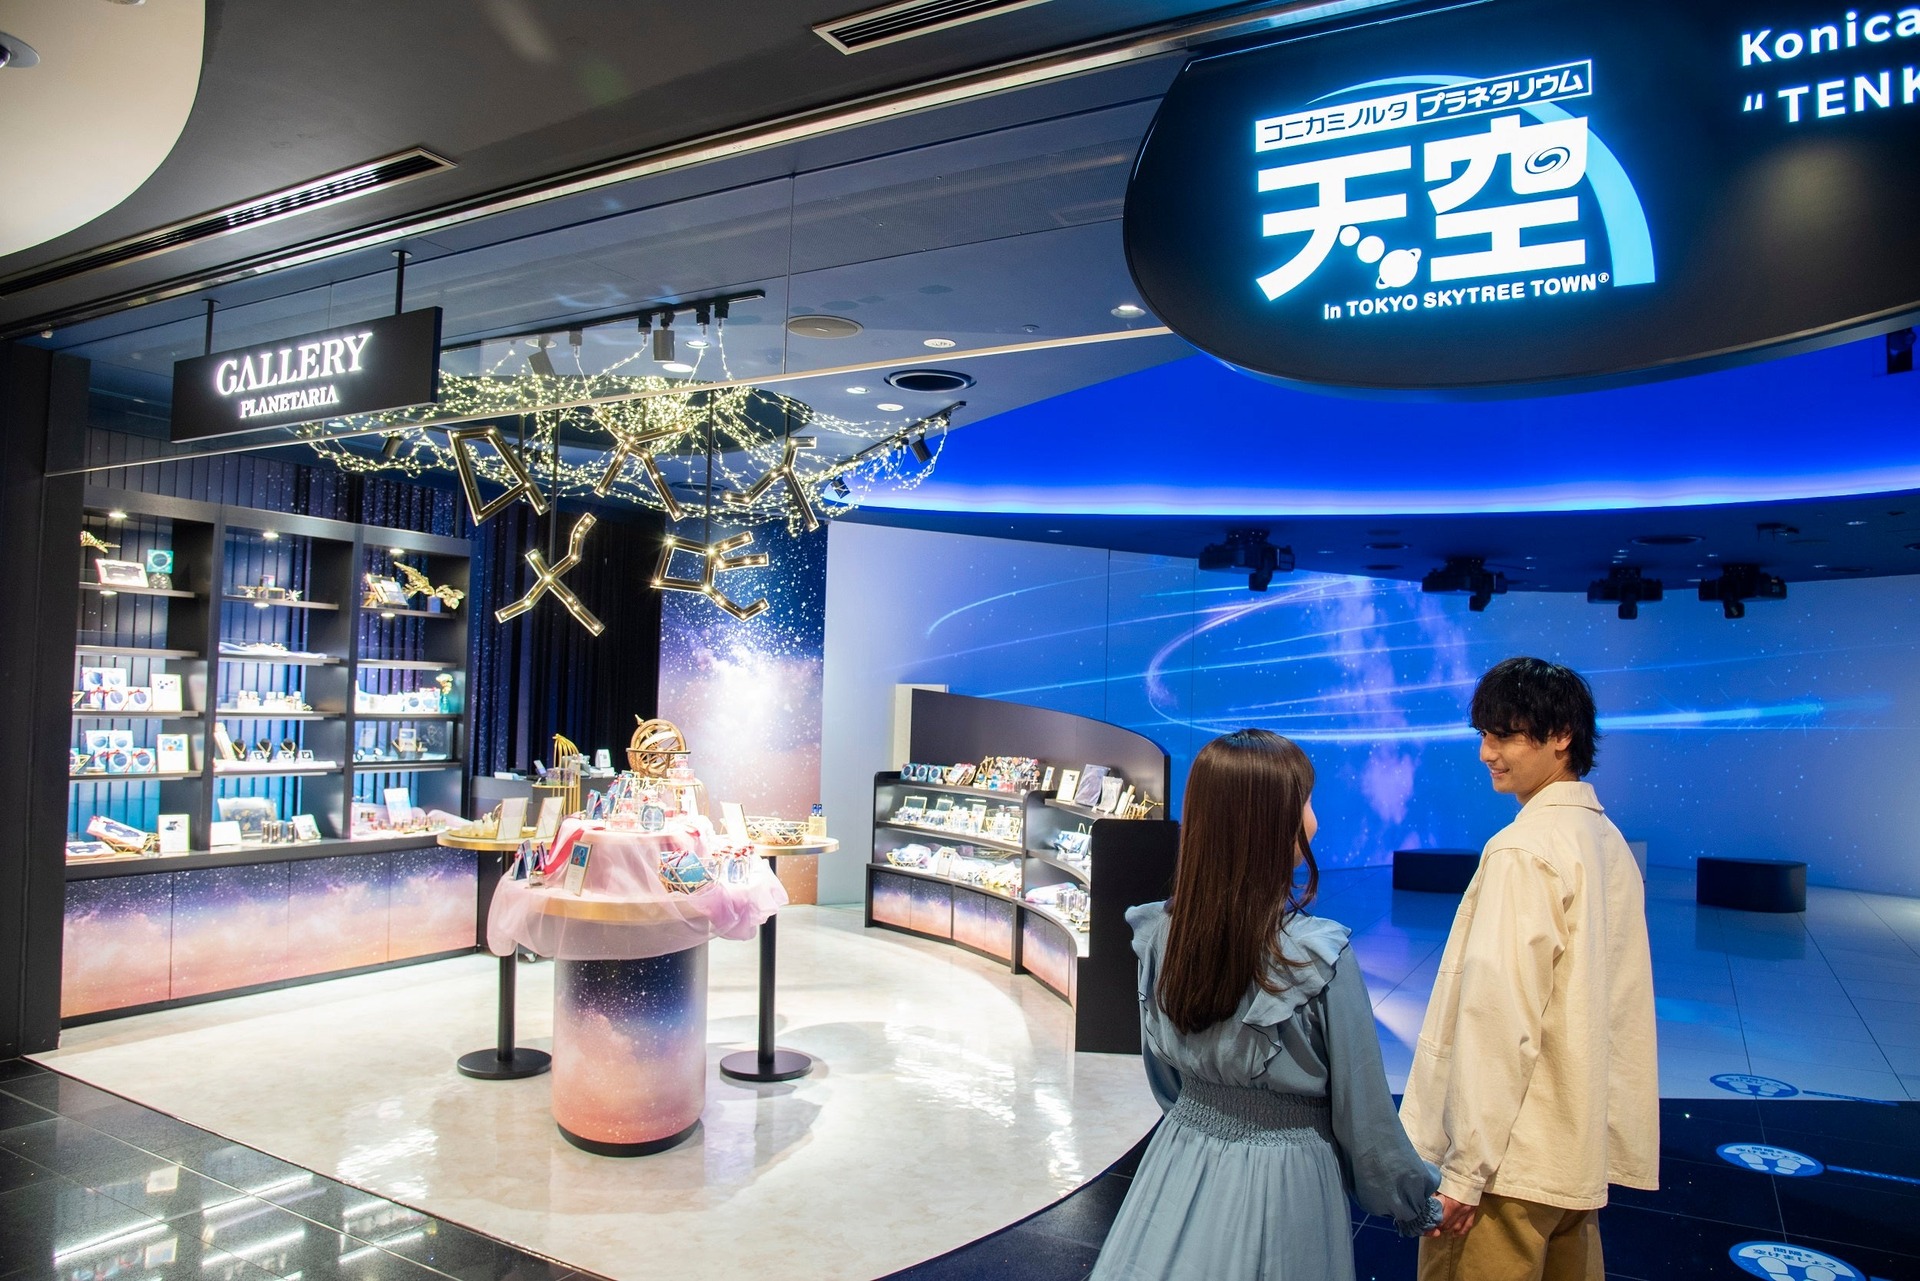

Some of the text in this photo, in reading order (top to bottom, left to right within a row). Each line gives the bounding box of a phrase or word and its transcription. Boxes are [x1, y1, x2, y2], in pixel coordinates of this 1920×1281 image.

[1742, 7, 1920, 67] Konica
[1264, 70, 1584, 143] コニカミノルタ プラネタリウム
[1256, 114, 1588, 301] 天空
[1324, 303, 1341, 320] in
[1346, 296, 1418, 317] TOKYO
[1423, 282, 1525, 309] SKYTREE
[216, 332, 373, 396] GALLERY
[240, 385, 339, 419] PLANETARIA
